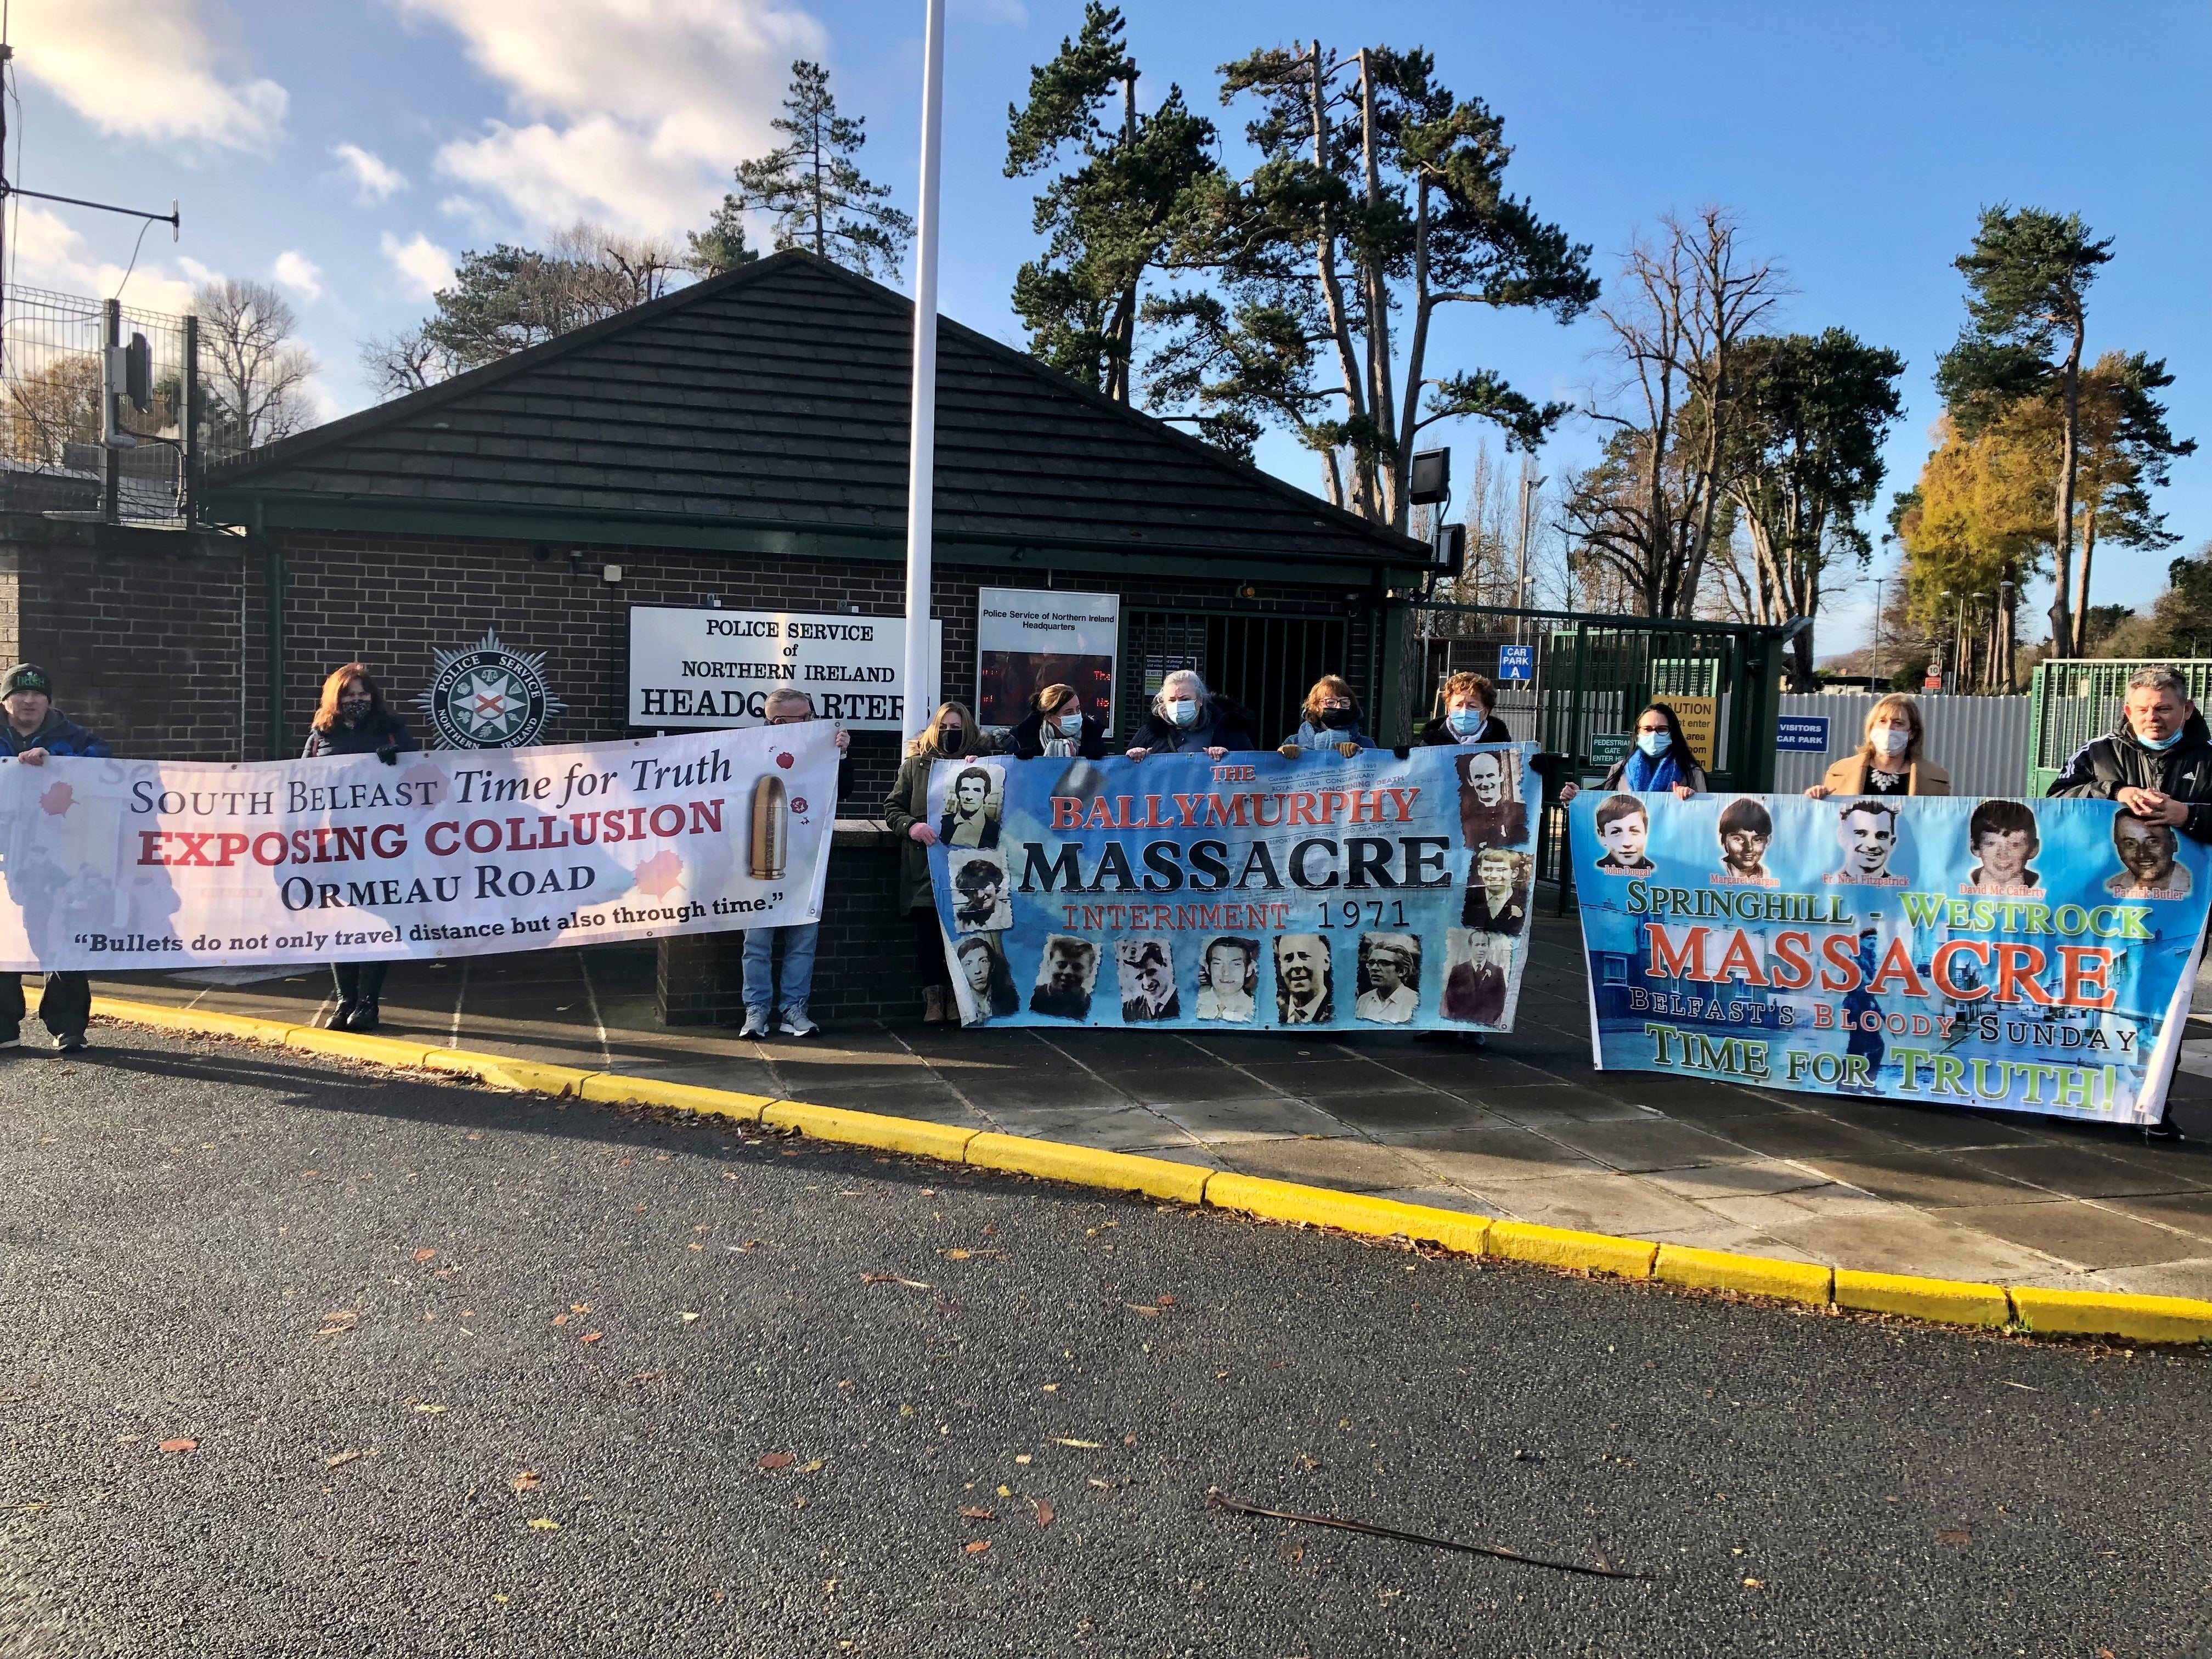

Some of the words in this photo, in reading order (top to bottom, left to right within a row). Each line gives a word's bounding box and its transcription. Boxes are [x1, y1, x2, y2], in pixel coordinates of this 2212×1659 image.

[983, 609, 1007, 618] Police
[1009, 611, 1040, 619] Service
[1052, 613, 1086, 622] Northern
[1088, 614, 1114, 623] Ireland
[1023, 621, 1075, 631] Headquarters
[706, 619, 780, 637] POLICE
[787, 622, 874, 642] SERVICE
[782, 644, 799, 657] of
[1503, 656, 1529, 665] PARK
[1507, 647, 1527, 656] CAR
[438, 654, 481, 693] POLICE
[498, 656, 541, 699] SERVICE
[681, 661, 797, 680] NORTHERN
[804, 664, 895, 683] IRELAND
[1510, 666, 1520, 678] A
[640, 688, 931, 721] HEADQRTER
[438, 708, 481, 749] NORTHERN
[500, 716, 538, 749] IRELAND
[1688, 720, 1711, 728] enter
[1779, 724, 1822, 732] VISITORS
[130, 780, 274, 816] SOUTH
[286, 780, 438, 814] BELFAST
[455, 769, 551, 803] Time
[556, 763, 618, 809] for
[630, 748, 732, 792] Truth
[1209, 764, 1256, 782] THE
[1316, 781, 1371, 793] CONCERNING
[1376, 775, 1404, 786] DEATH
[1049, 787, 1422, 830] BALLYMURPHY
[137, 823, 408, 867] EXPOSING
[424, 798, 725, 856] COLLUSION
[1017, 836, 1453, 894] MASSACRE
[1604, 864, 1623, 876] John
[1624, 866, 1651, 878] Dougal
[281, 876, 461, 911] ORMEAU
[474, 864, 596, 899] ROAD
[1710, 874, 1748, 886] Margaret
[1750, 876, 1780, 887] Gargan
[1821, 873, 1836, 884] Fr.
[1837, 873, 1859, 884] Noel
[1860, 874, 1910, 888] Fitzpatrick
[1959, 883, 1987, 895] David
[1990, 886, 2004, 895] Mc
[2006, 886, 2046, 899] Cafferty
[2113, 886, 2149, 898] Patrick
[2152, 888, 2184, 900] Butler
[1062, 904, 1289, 931] INTERNMENT
[1317, 900, 1410, 928] 1971
[1627, 880, 1854, 924] SPRINGHILL
[1898, 891, 2156, 939] WESTROCK
[75, 933, 183, 952] “Bullets
[191, 934, 222, 951] do
[228, 934, 268, 950] not
[275, 931, 329, 951] only
[335, 926, 403, 946] travel
[409, 924, 505, 942] distance
[511, 917, 551, 934] but
[557, 911, 606, 930] also
[612, 901, 706, 927] through
[712, 892, 785, 915] time.”
[1645, 922, 2118, 1009] MASSACRE
[1813, 1003, 1955, 1037] BLOODY
[1979, 1015, 2138, 1052] SUNDAY
[1645, 1023, 1770, 1079] TIME
[1786, 1049, 1875, 1087] FOR
[1891, 1047, 2118, 1111] TRUTH!
